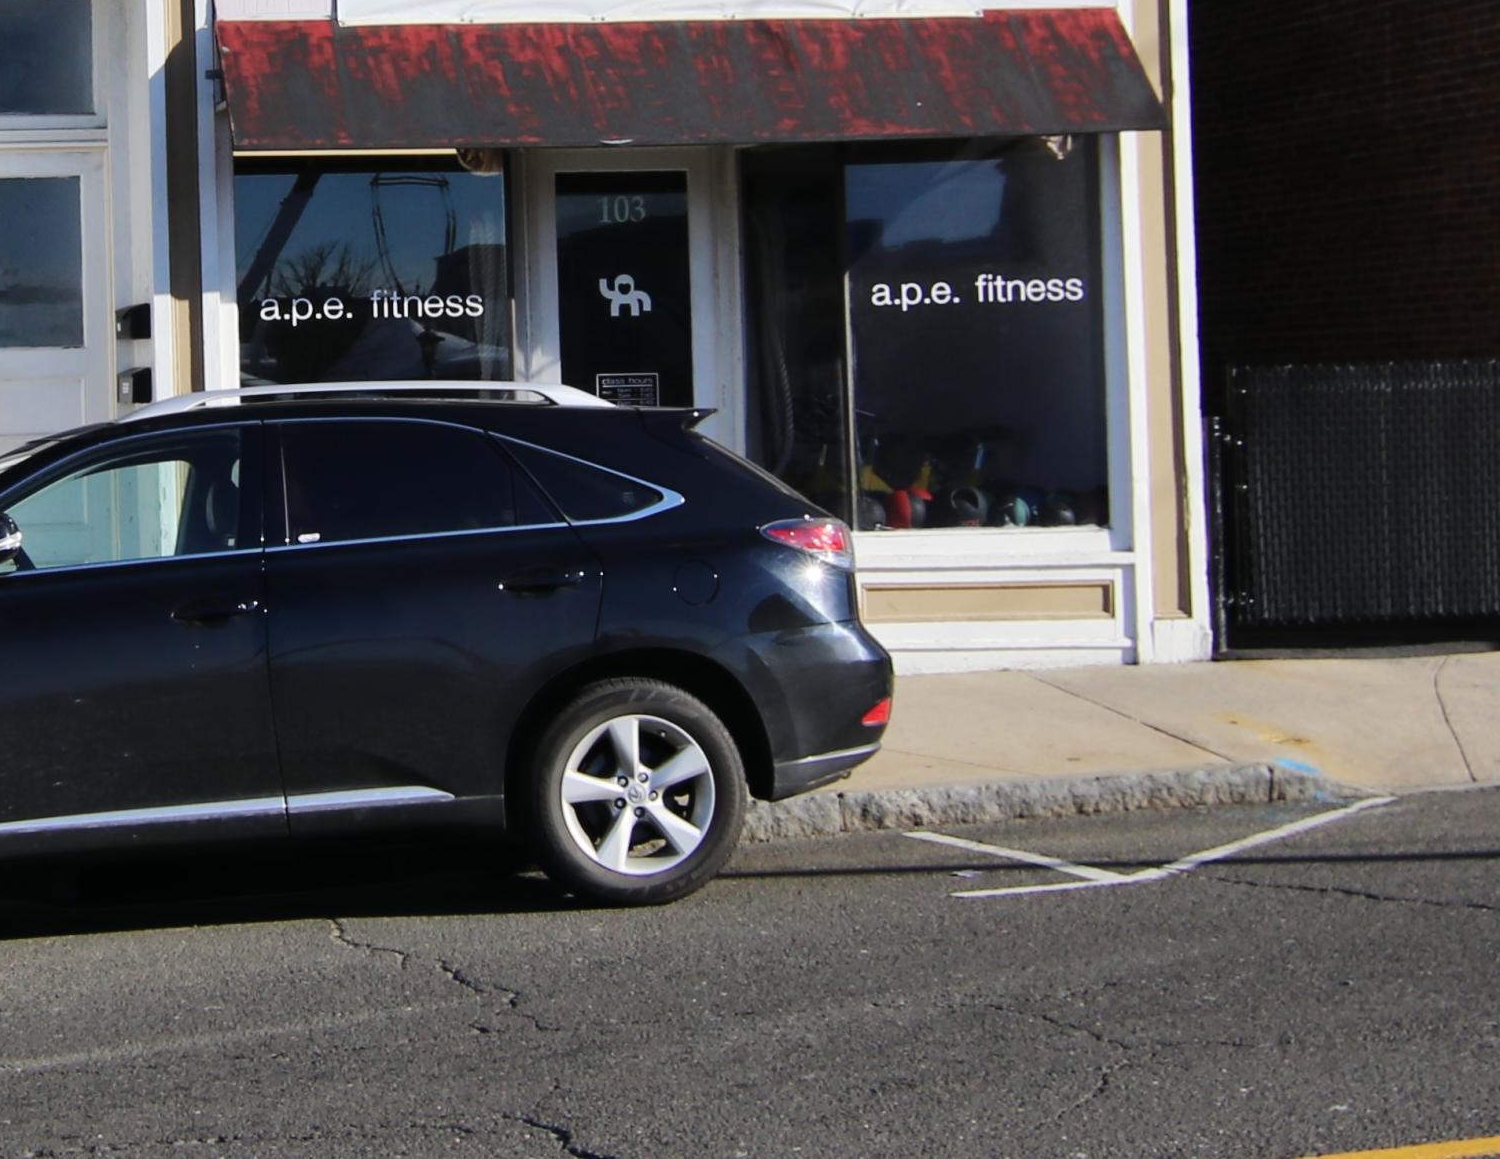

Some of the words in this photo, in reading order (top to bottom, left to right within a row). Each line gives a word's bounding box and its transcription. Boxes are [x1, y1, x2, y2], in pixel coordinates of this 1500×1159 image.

[597, 195, 647, 223] 103
[259, 296, 353, 327] a.p.e.
[370, 289, 485, 319] fitness
[871, 281, 960, 312] a.p.e.
[975, 273, 1085, 303] fitness
